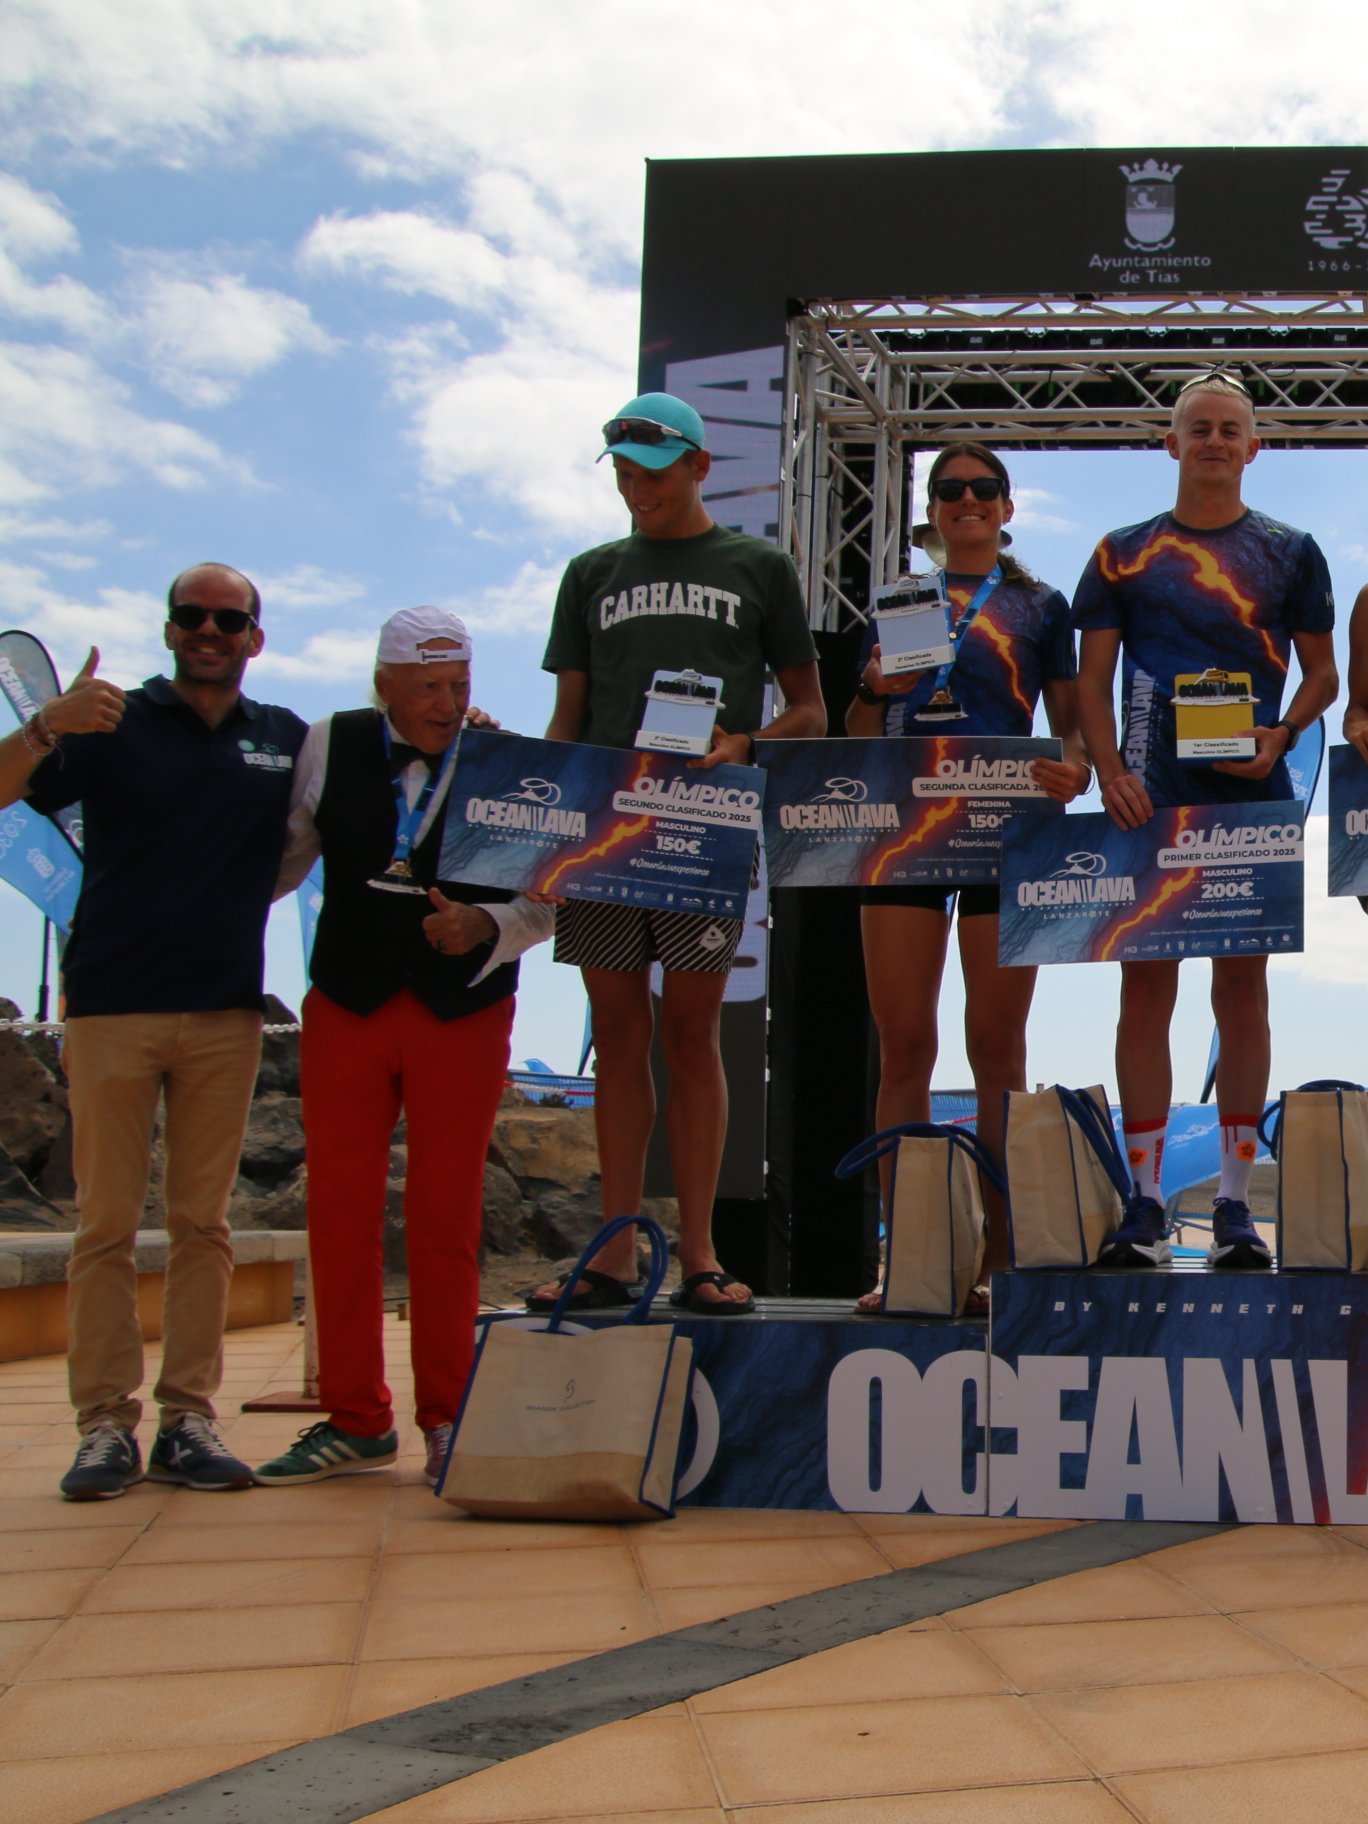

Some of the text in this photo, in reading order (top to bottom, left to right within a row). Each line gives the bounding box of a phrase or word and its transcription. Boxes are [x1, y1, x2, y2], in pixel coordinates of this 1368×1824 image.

[1089, 254, 1211, 272] Ayuntamiento
[1120, 270, 1141, 284] de
[600, 582, 741, 630] CARHARTT
[632, 776, 760, 811] OLÍMPICO
[919, 783, 966, 792] SEGUNDA
[967, 782, 1031, 791] CLASIFICADA
[618, 797, 752, 823] SEGUNDO CLASIFICADO 2025
[967, 800, 1012, 808] FEMENINA
[655, 820, 707, 835] MASCULINO
[1175, 823, 1302, 848] OLÍMPICO
[656, 835, 702, 856] 150€
[1163, 848, 1296, 863] PRIMER CLASIFICADO 2025
[1202, 867, 1253, 878] MASCULINO
[1201, 881, 1255, 900] 200€
[1053, 1302, 1093, 1312] BY
[1128, 1302, 1303, 1315] KENNETH
